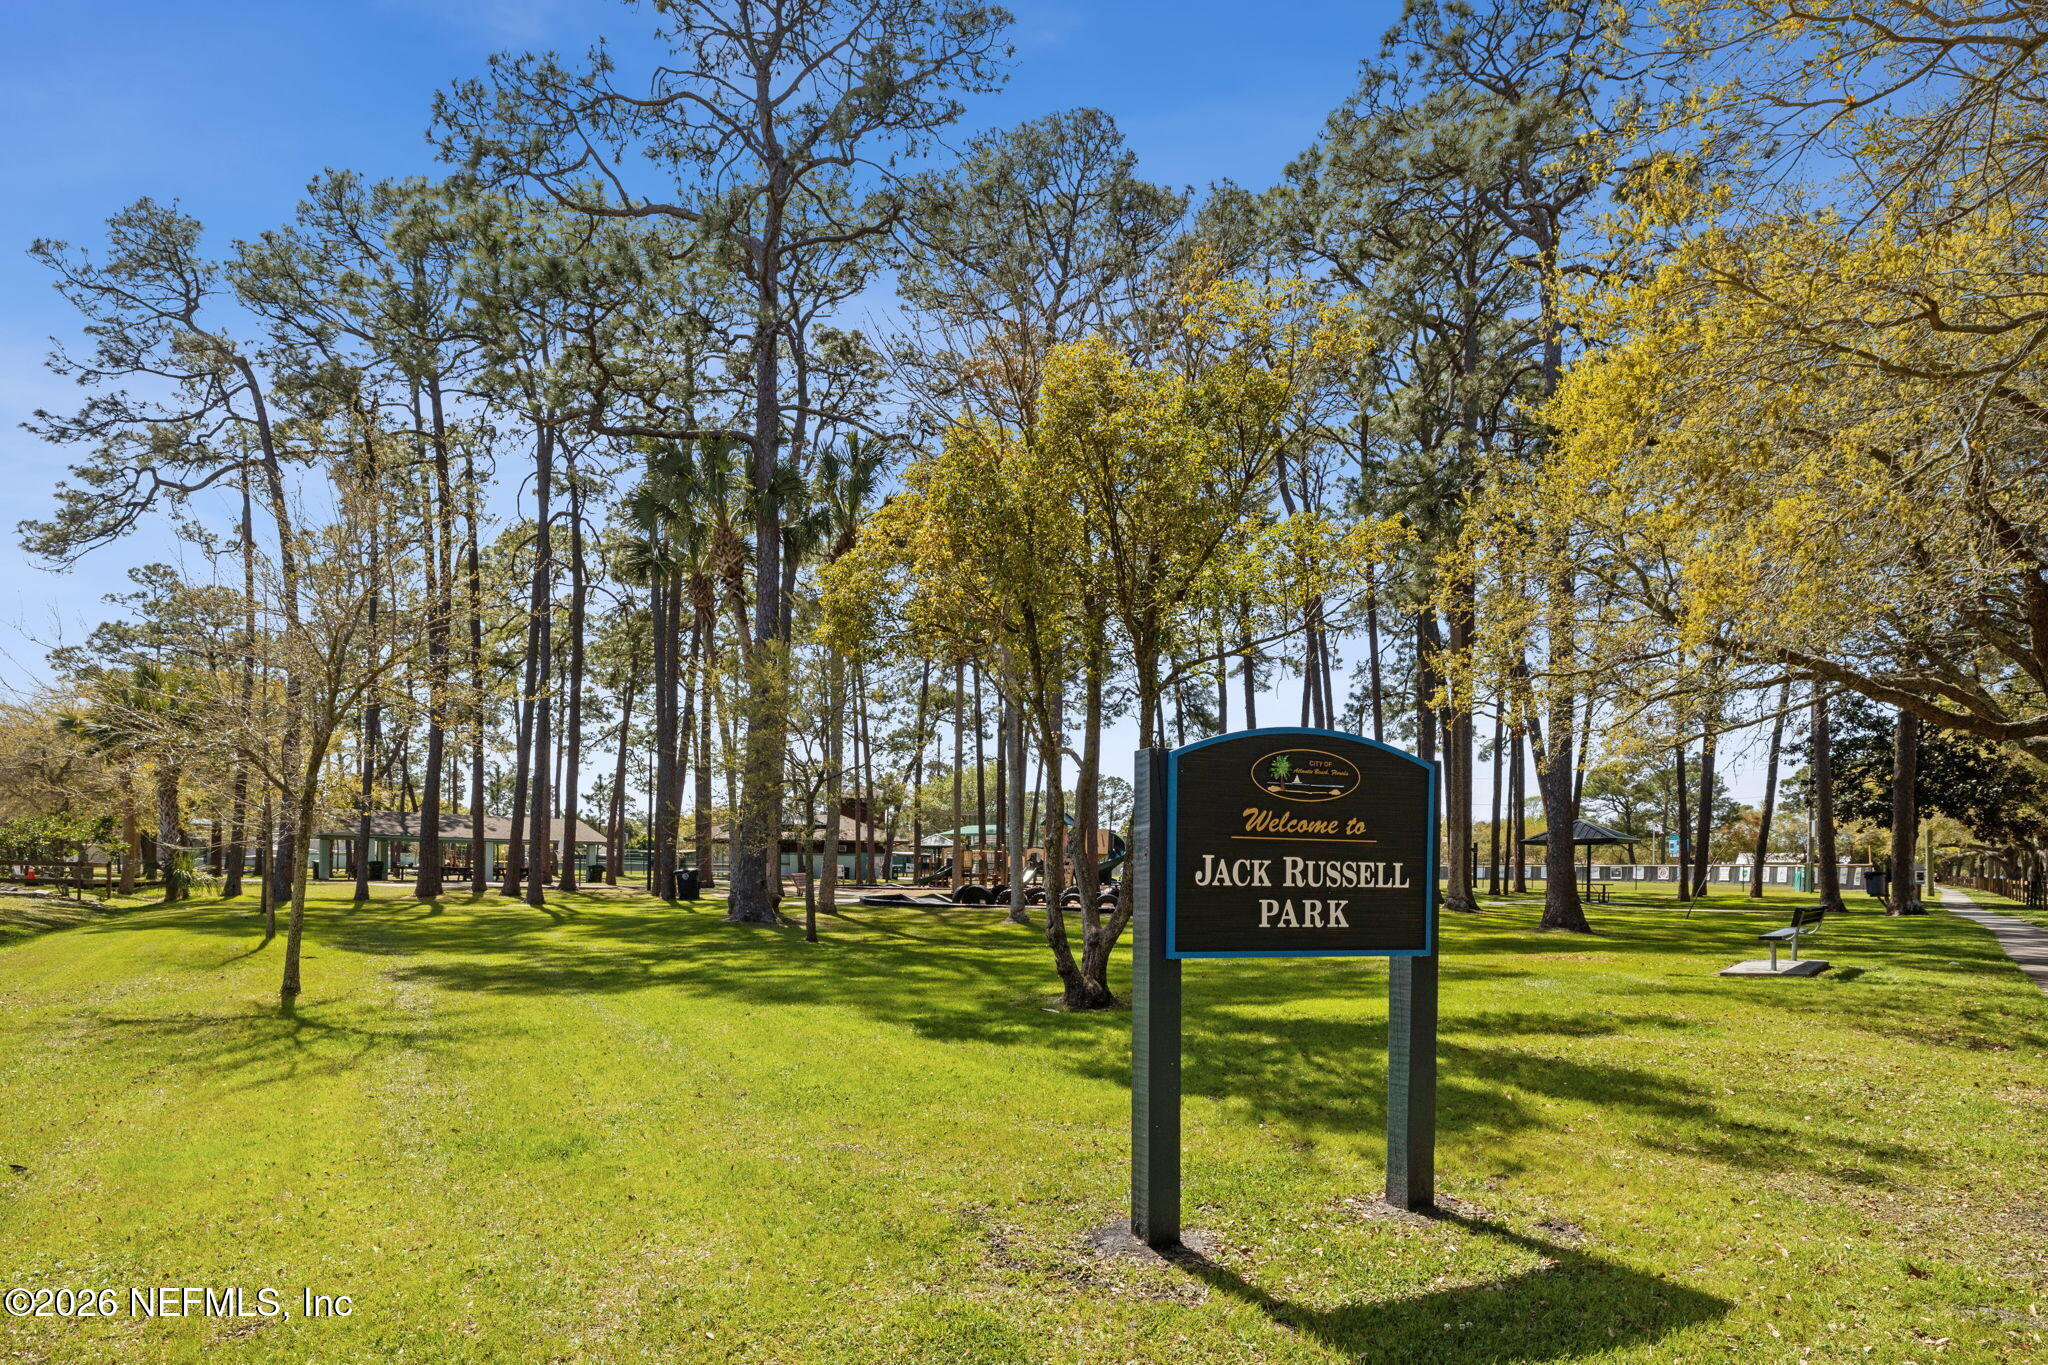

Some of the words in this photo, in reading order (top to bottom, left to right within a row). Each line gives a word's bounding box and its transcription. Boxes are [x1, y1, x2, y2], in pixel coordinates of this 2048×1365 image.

[1242, 807, 1339, 834] Welcome
[1345, 816, 1367, 836] to
[1195, 854, 1272, 888] JACK
[1282, 856, 1410, 889] RUSSELL
[1258, 899, 1350, 929] PARK
